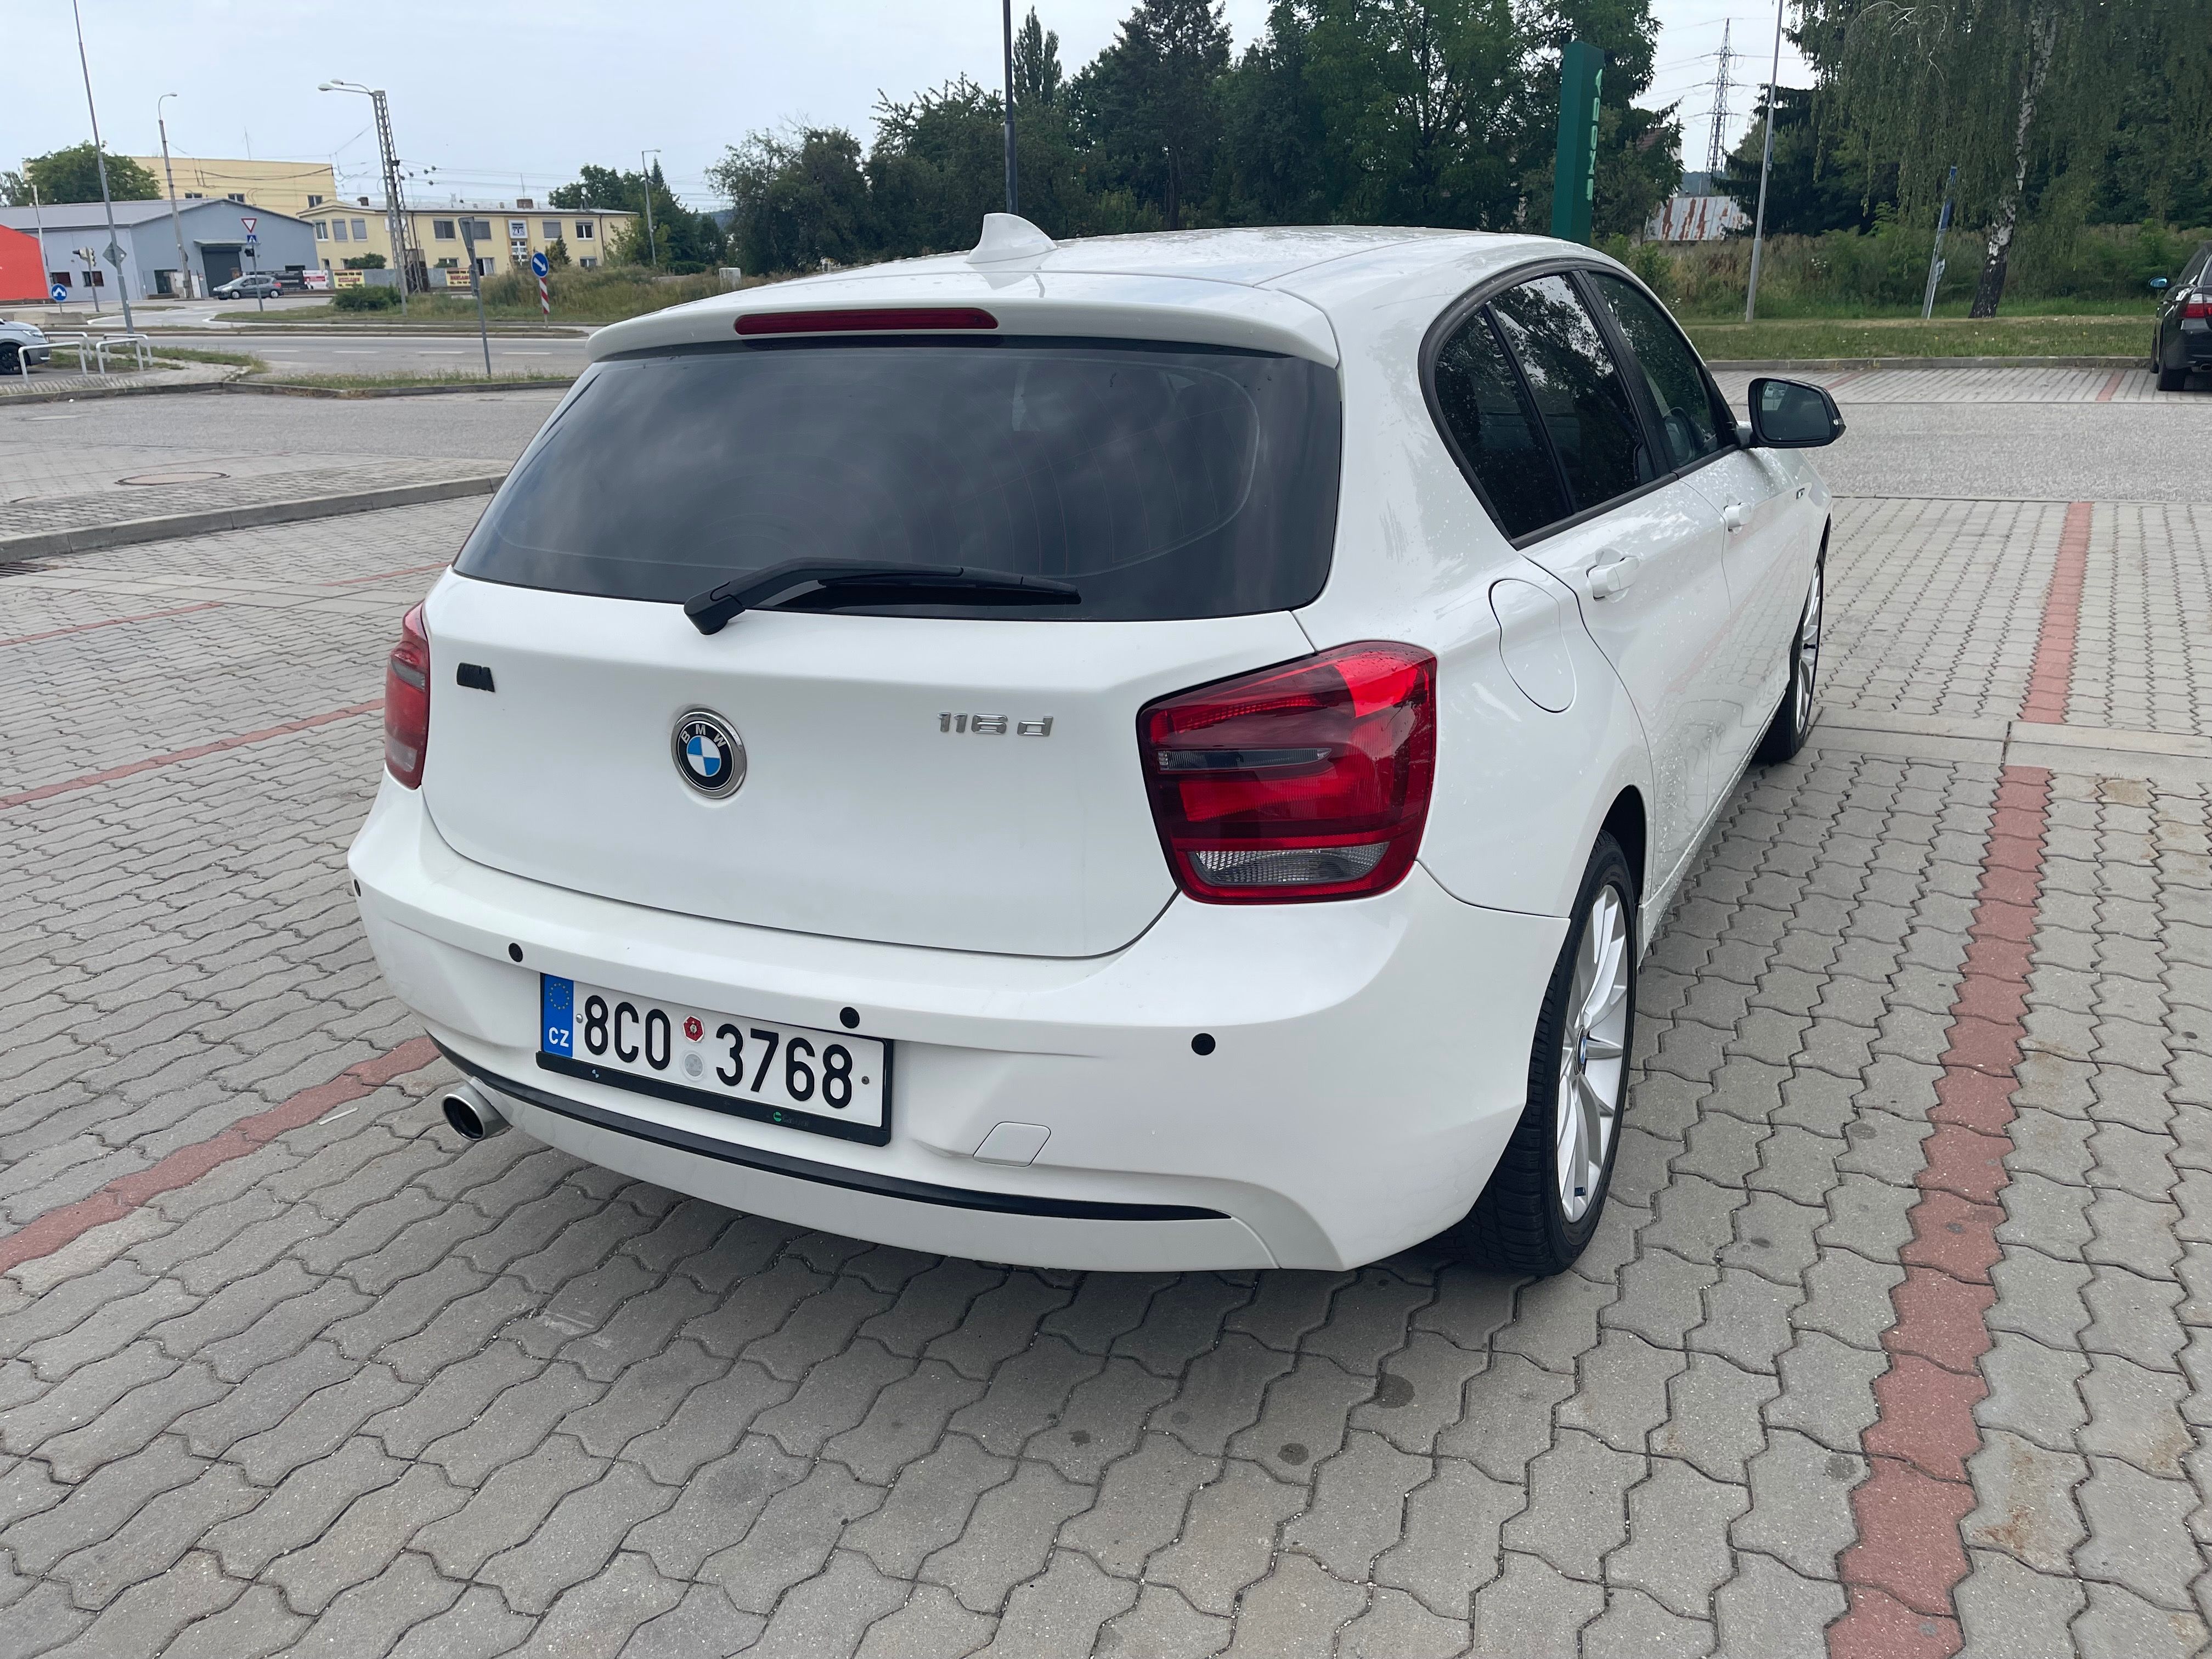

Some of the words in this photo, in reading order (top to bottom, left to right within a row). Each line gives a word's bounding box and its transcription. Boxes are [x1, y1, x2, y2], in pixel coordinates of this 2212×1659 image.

[681, 724, 726, 748] BMW
[937, 712, 1008, 735] 116
[1017, 716, 1053, 737] d
[549, 1026, 569, 1048] CZ
[584, 995, 671, 1070] 8C0
[716, 1023, 853, 1109] 3768
